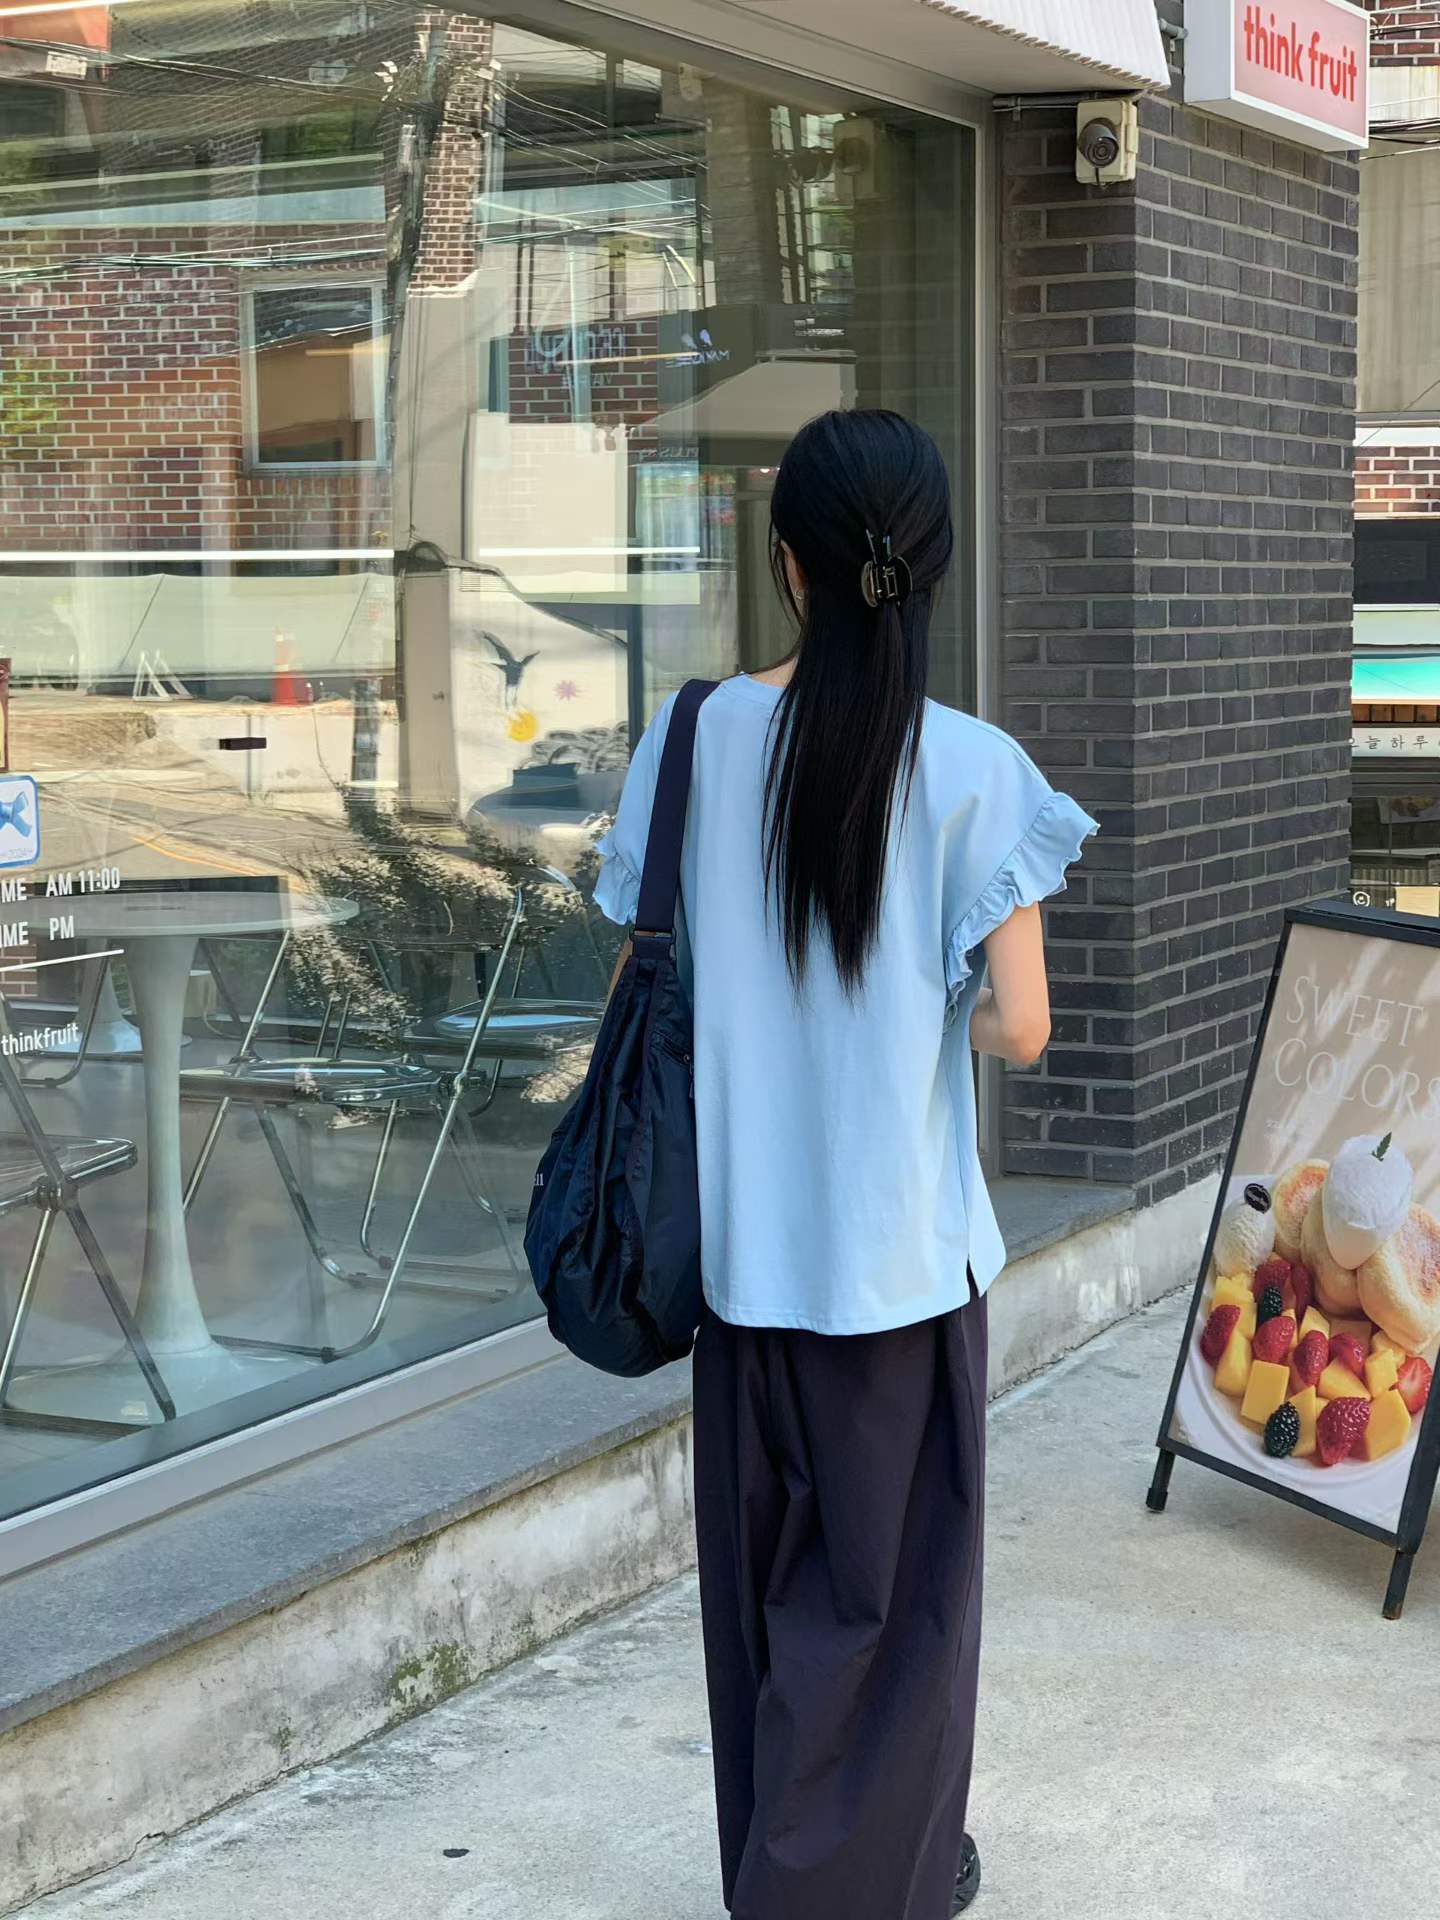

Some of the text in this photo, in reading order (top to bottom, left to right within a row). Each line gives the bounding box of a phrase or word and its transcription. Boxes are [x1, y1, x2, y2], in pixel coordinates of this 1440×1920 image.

[1244, 5, 1358, 102] think fruit
[1348, 734, 1440, 751] 오늘하루
[1, 867, 120, 903] ME AM 11:00
[49, 915, 75, 941] PM
[1286, 975, 1425, 1048] SWEET
[1, 1022, 79, 1056] thinkfruit
